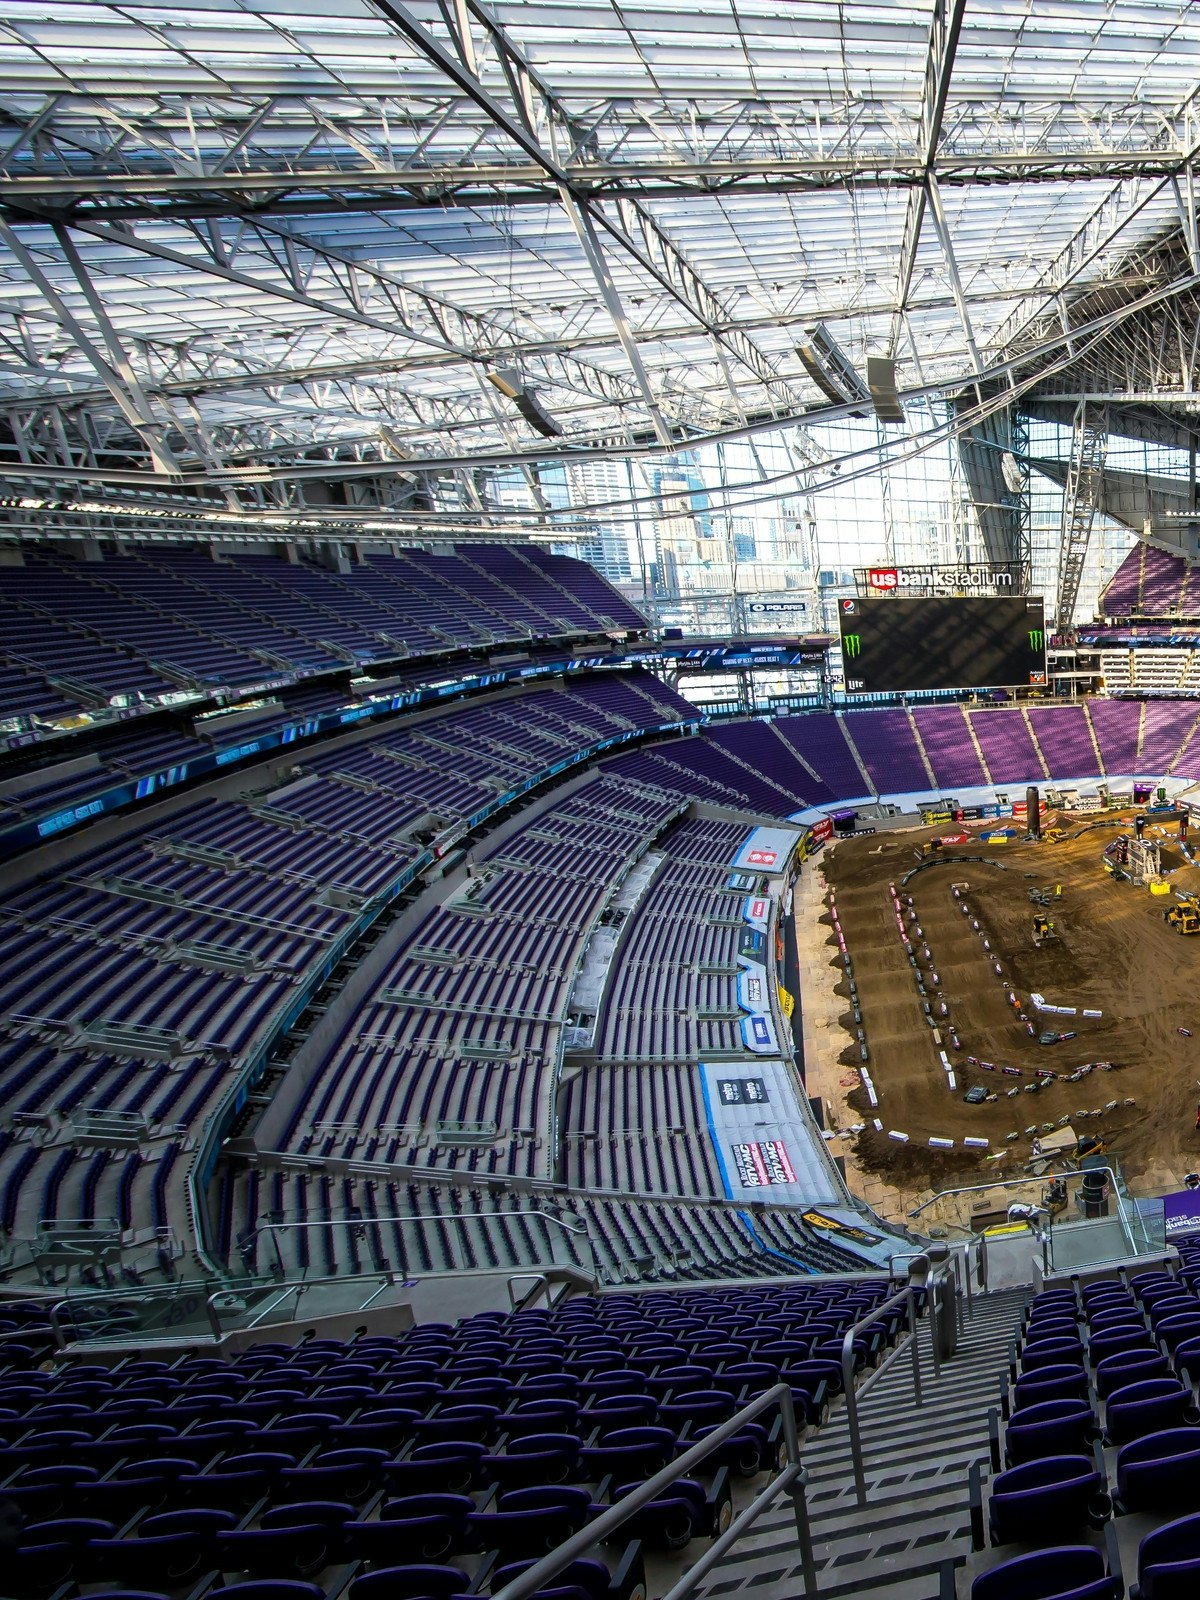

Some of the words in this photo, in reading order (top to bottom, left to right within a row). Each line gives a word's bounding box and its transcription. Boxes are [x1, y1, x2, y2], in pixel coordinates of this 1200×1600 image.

[824, 675, 842, 683] 12:42
[848, 680, 864, 689] Lite
[723, 1083, 734, 1100] metro
[746, 1082, 757, 1099] metro
